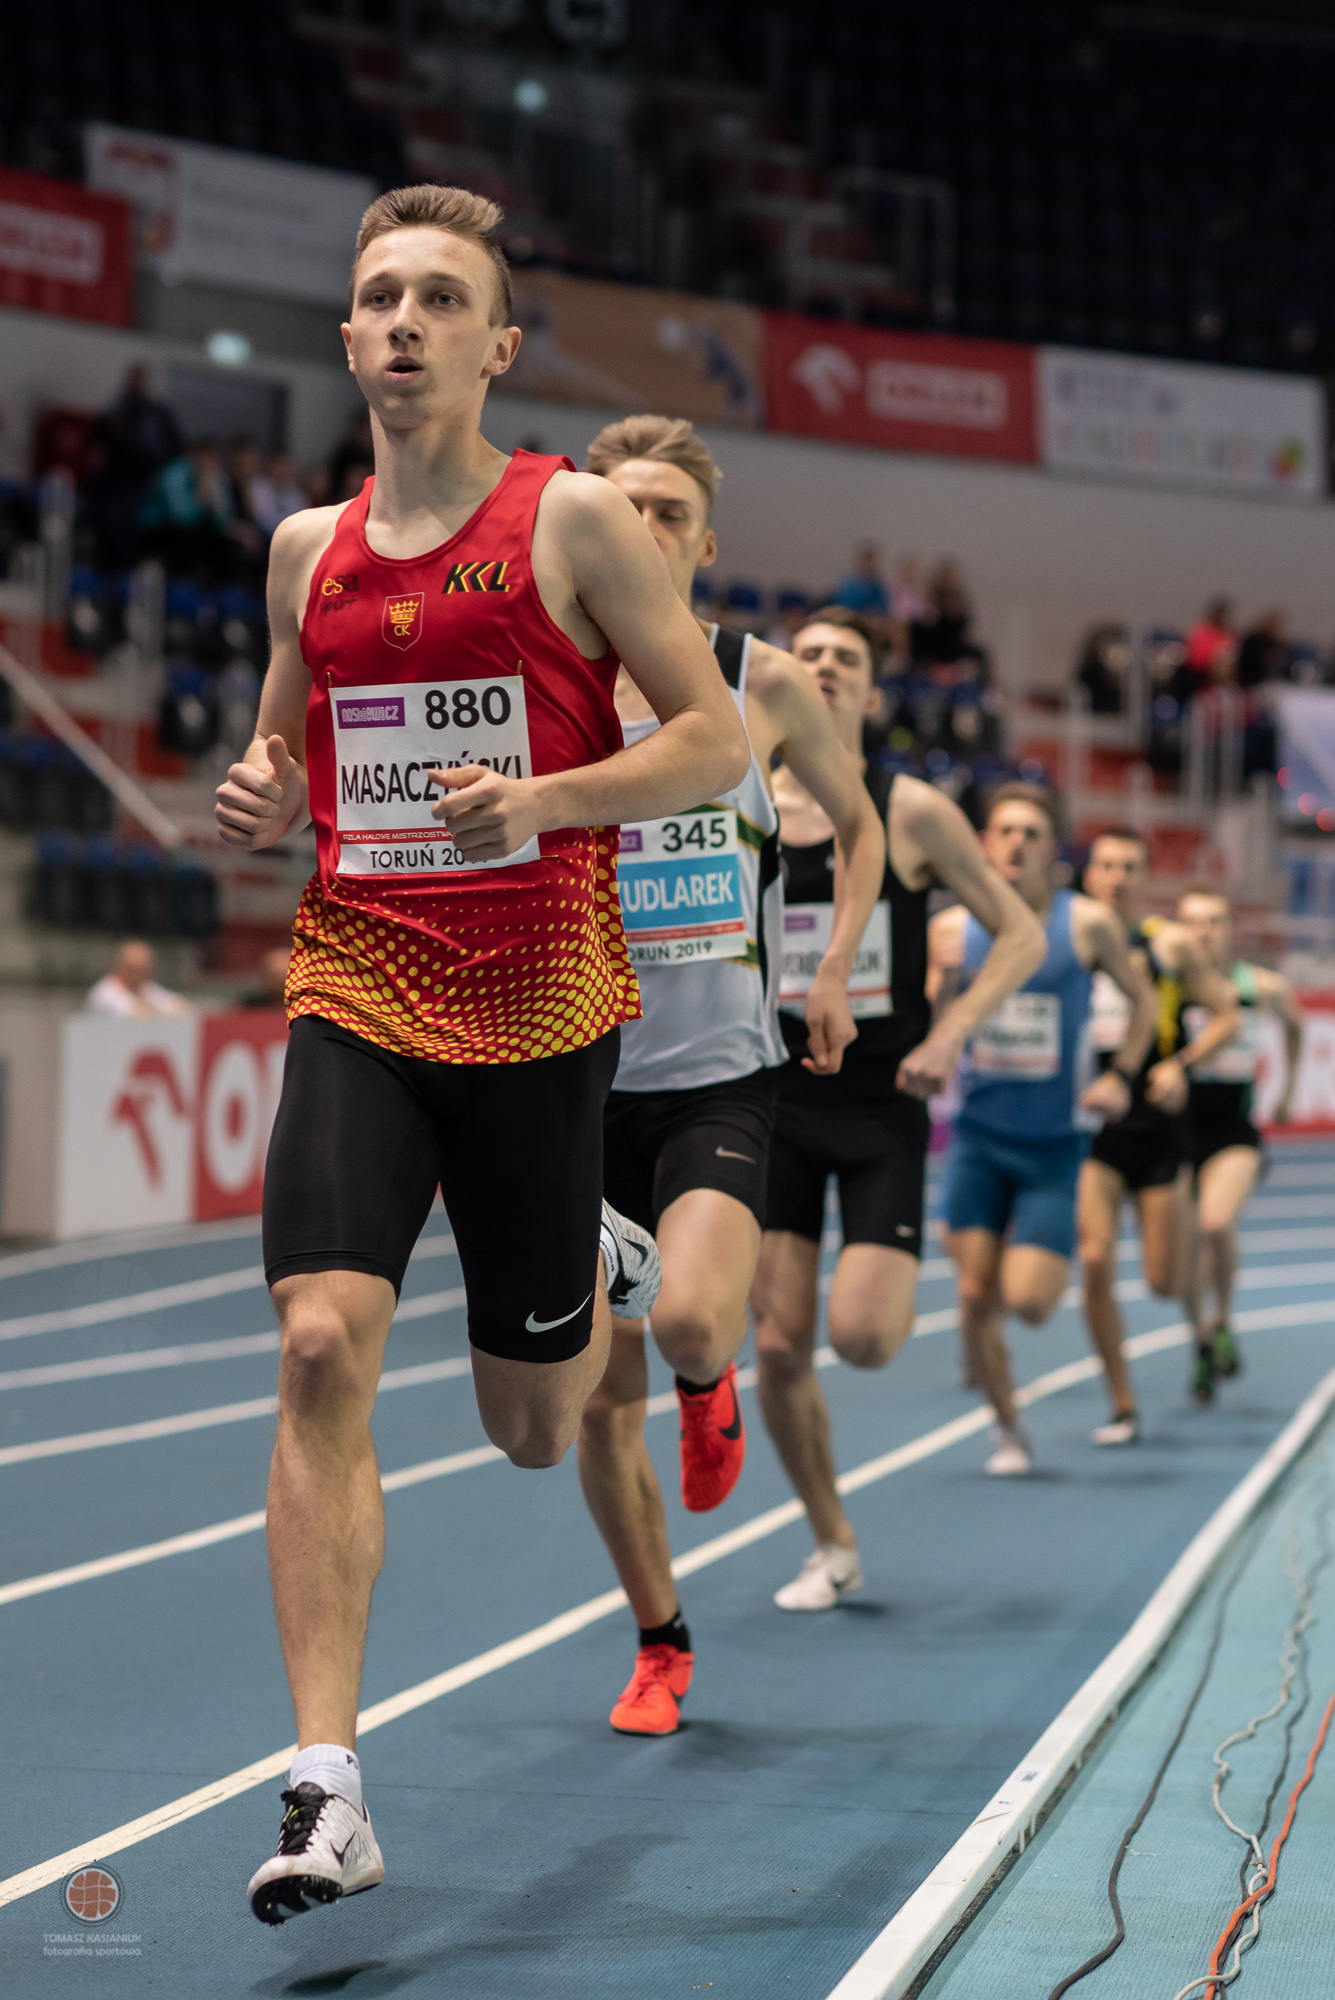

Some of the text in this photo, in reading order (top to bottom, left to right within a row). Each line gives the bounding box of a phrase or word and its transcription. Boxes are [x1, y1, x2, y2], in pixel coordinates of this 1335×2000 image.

[394, 624, 411, 636] CK
[425, 685, 511, 730] 880
[661, 817, 727, 853] 345
[370, 843, 434, 869] TORUŃ
[627, 940, 713, 962] ORUŃ 2019
